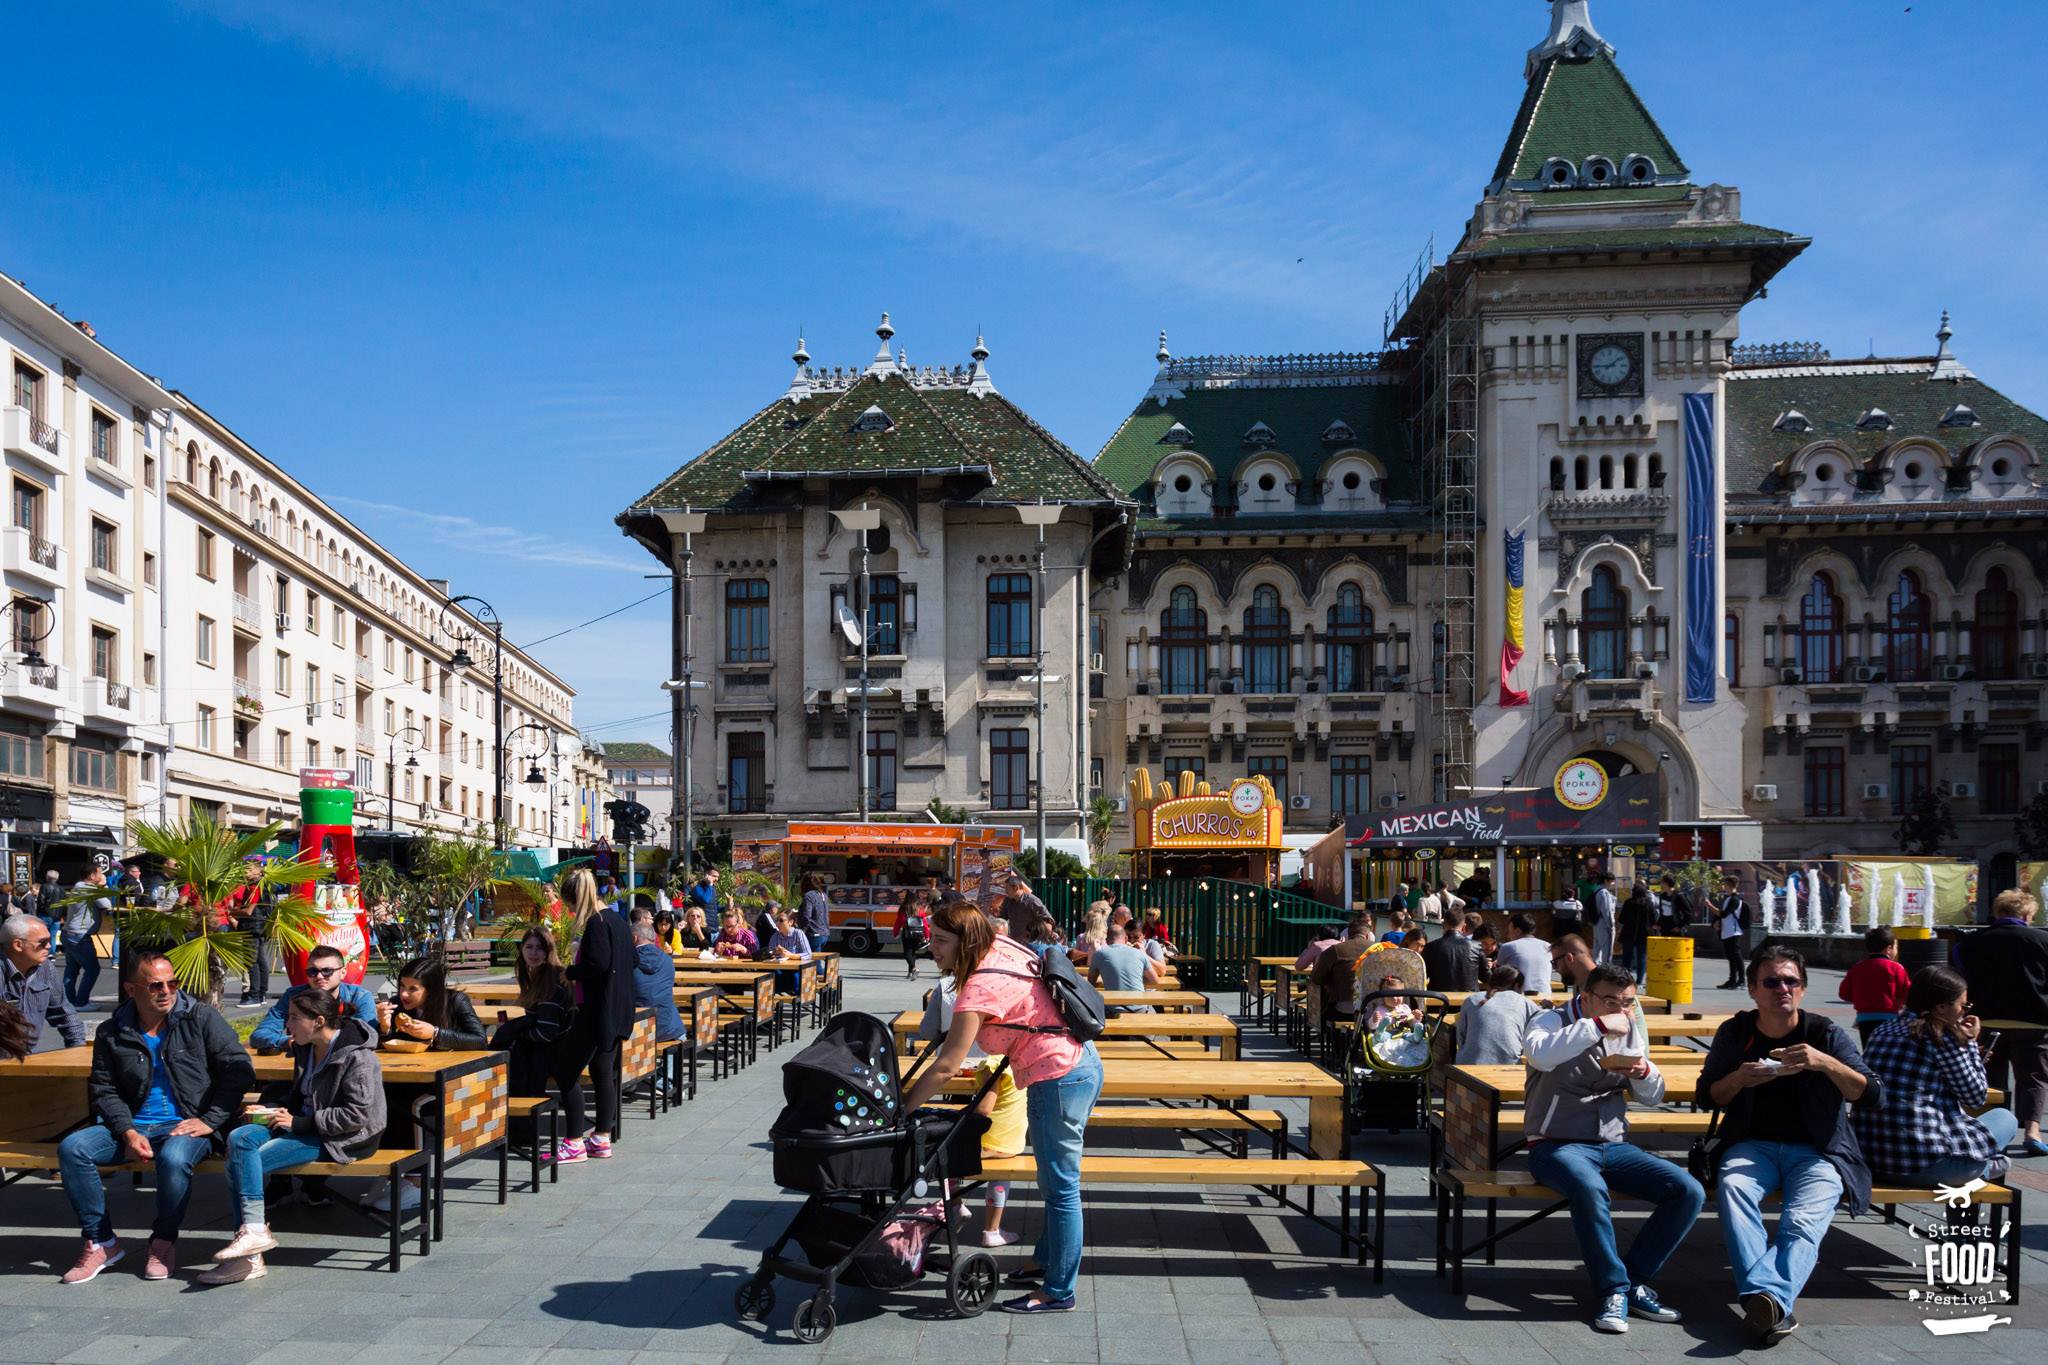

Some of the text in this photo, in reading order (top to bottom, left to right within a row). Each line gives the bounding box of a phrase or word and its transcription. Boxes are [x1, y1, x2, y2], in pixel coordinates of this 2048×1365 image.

[1159, 813, 1257, 839] CHURROS by
[1381, 806, 1480, 837] MEXICAN
[1465, 821, 1503, 840] Food
